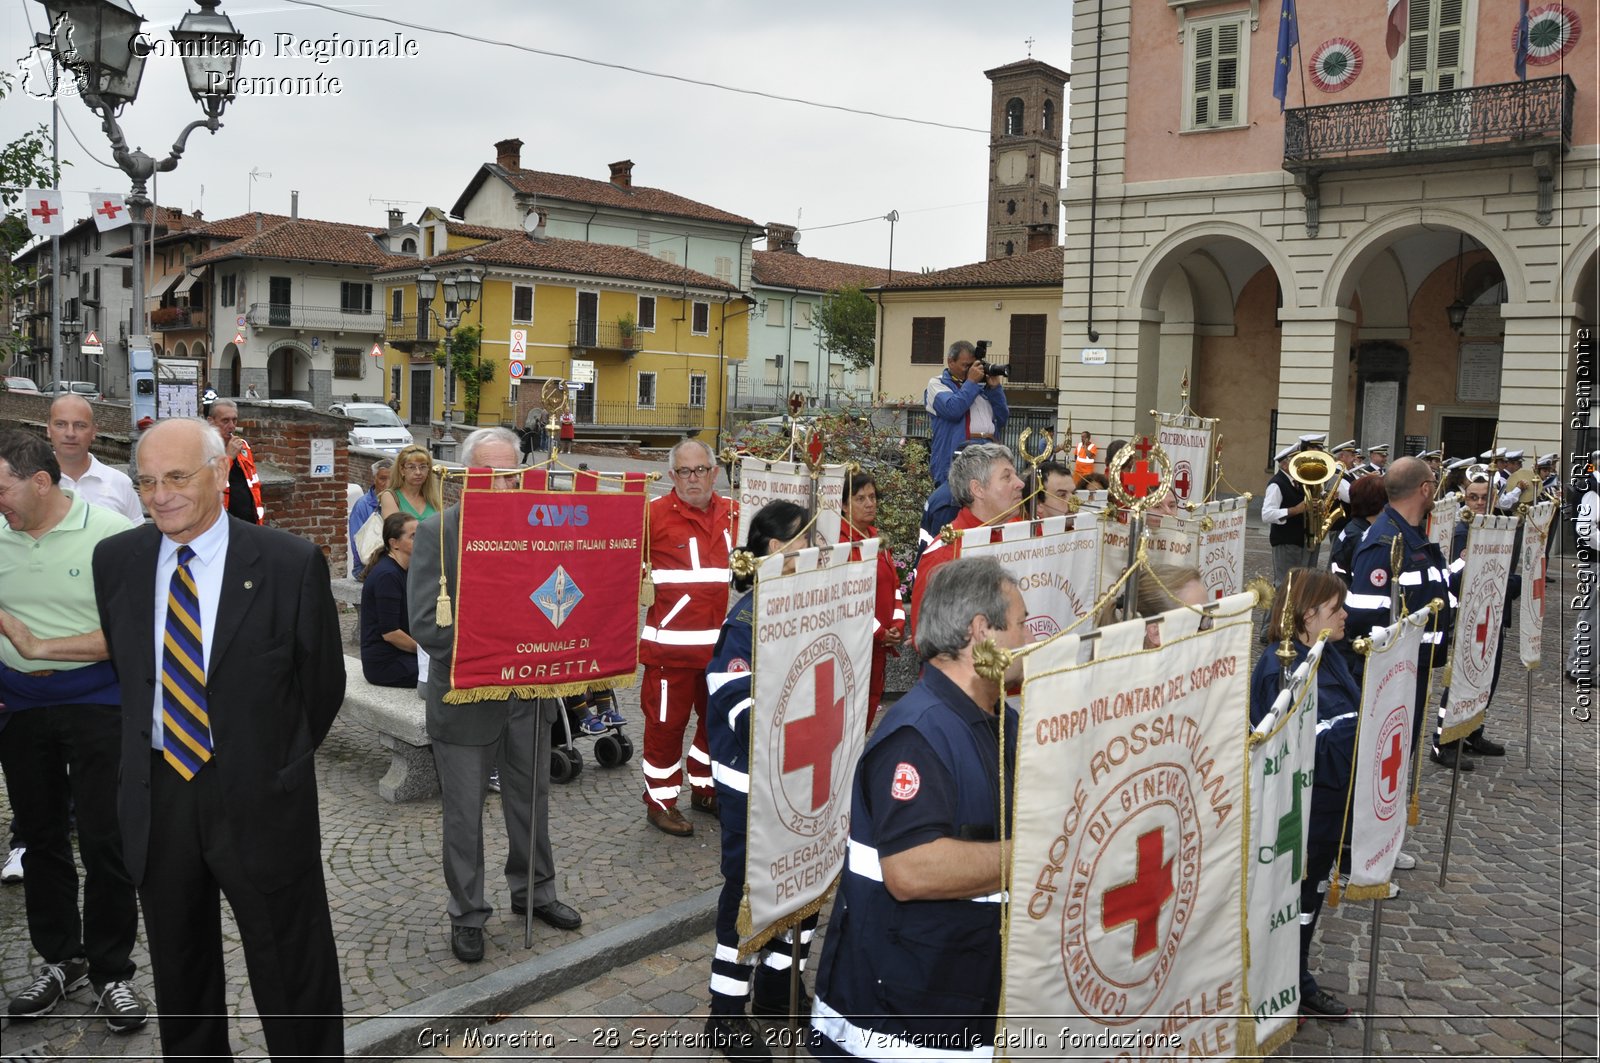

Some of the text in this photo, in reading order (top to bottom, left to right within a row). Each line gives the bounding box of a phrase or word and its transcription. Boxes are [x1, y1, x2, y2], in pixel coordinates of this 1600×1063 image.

[527, 503, 590, 527] AVIS
[466, 538, 637, 552] ASSOCIAZIONE VOLONTARI ITALIANI SANGUE
[1018, 572, 1053, 592] OSSA
[759, 596, 875, 643] CROCE ROSSA ITALIANA
[766, 595, 791, 616] CORPO
[516, 638, 590, 654] COMUNALE DI
[501, 659, 601, 680] MORETTA
[774, 636, 830, 729] CONVENZIONE
[1036, 707, 1088, 746] CORPO
[1090, 682, 1165, 727] VOLONTARI
[1167, 673, 1187, 703] DEL
[1120, 769, 1187, 812] GINEVRA
[1027, 713, 1233, 920] CROCE ROSSA ITALIANA
[1088, 811, 1113, 846] DI
[775, 838, 847, 905] PEVERAGNO
[1175, 830, 1198, 926] AGOSTO
[1065, 859, 1129, 1016] CONVENZIONE
